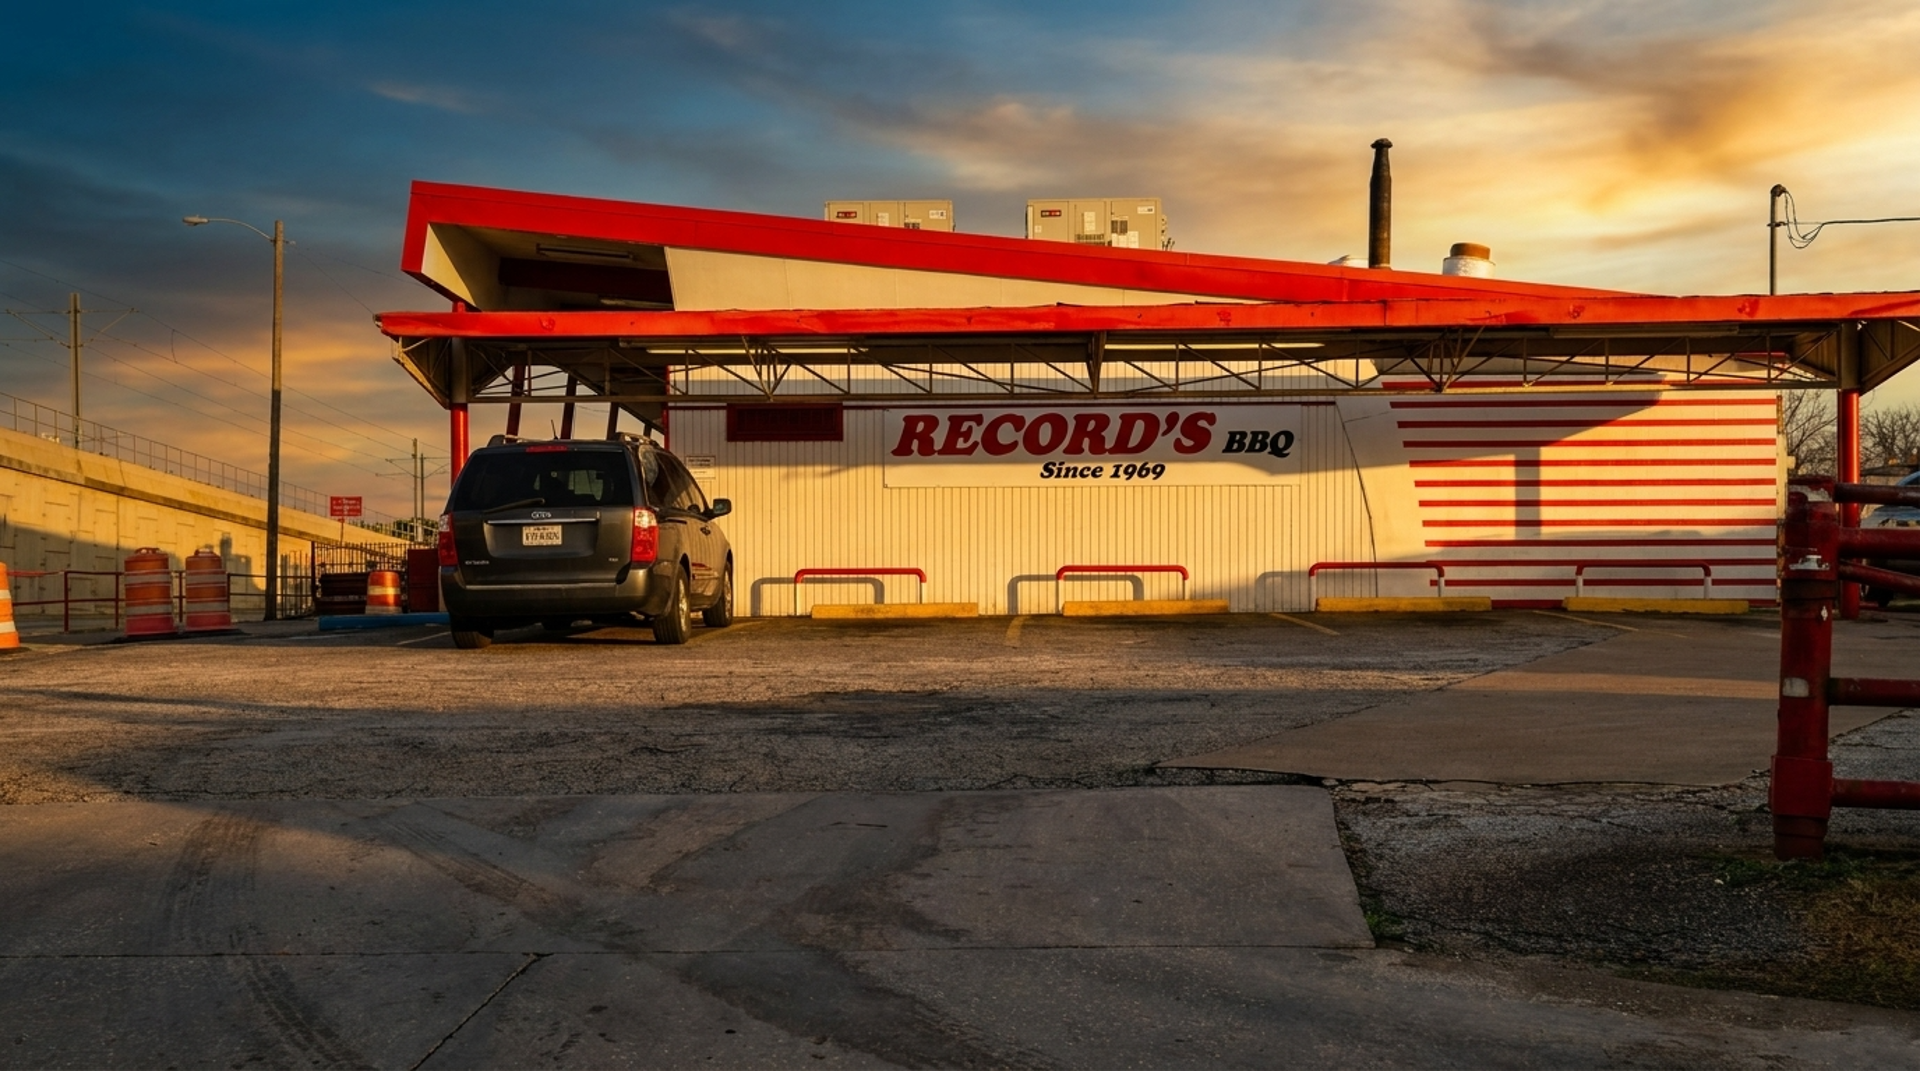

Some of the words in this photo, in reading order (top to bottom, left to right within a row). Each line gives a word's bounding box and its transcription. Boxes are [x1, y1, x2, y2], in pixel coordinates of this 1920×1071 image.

[891, 411, 1217, 456] RECORD'S
[1222, 430, 1294, 457] BBQ
[1040, 461, 1103, 479] Since
[1110, 462, 1166, 481] 1969
